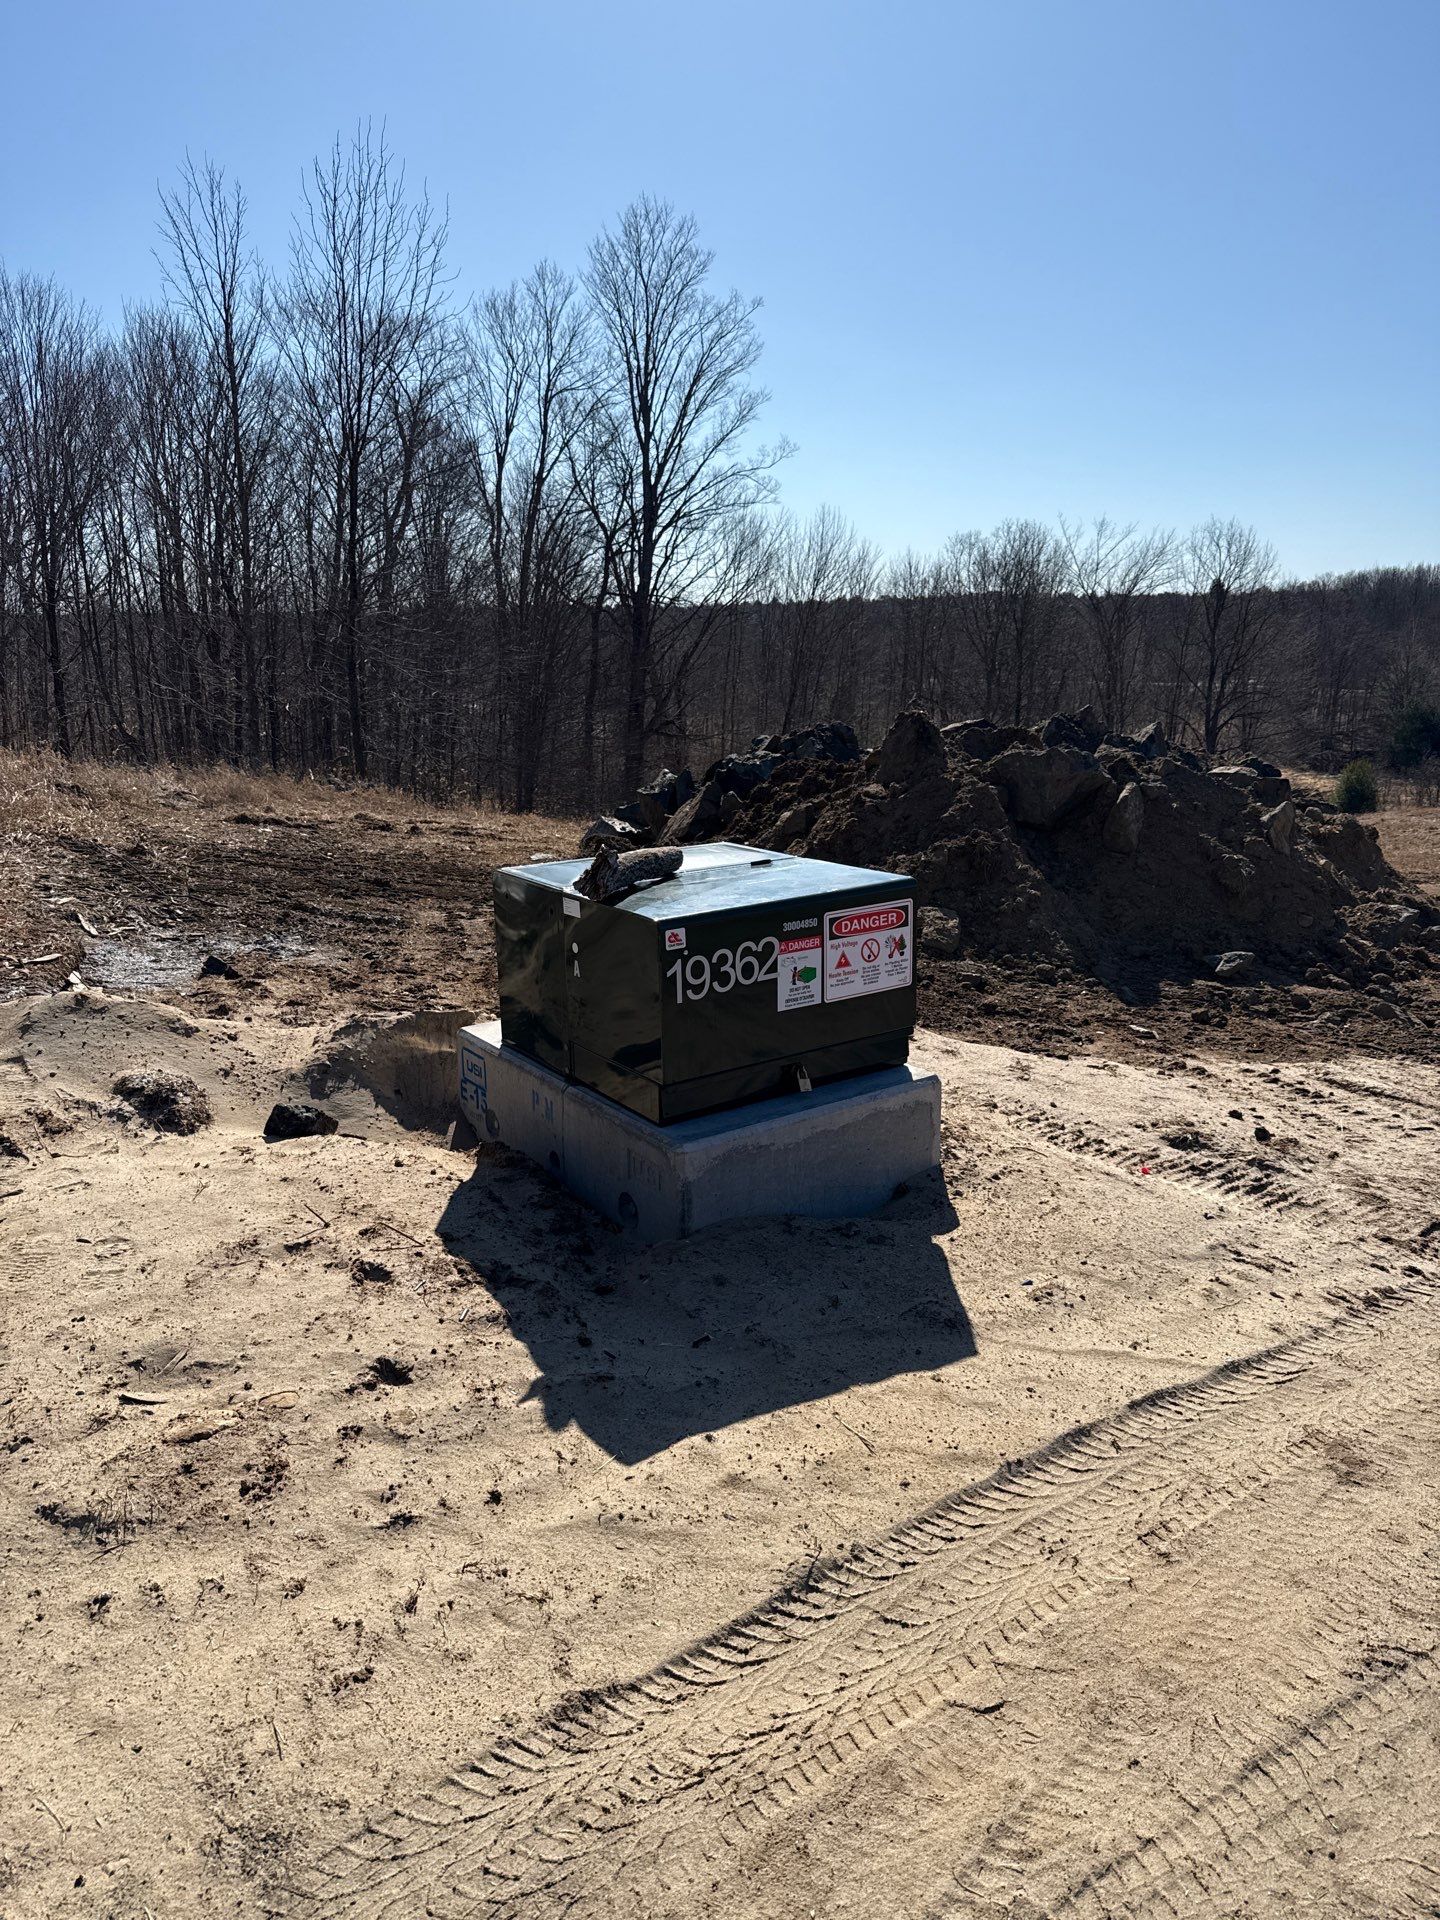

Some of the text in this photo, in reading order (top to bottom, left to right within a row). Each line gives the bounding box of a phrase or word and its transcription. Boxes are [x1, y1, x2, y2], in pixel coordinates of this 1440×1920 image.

[782, 917, 818, 932] 30004850
[841, 912, 897, 933] DANGER
[788, 937, 820, 951] DANGER
[573, 959, 581, 978] A
[666, 936, 780, 1004] 19362
